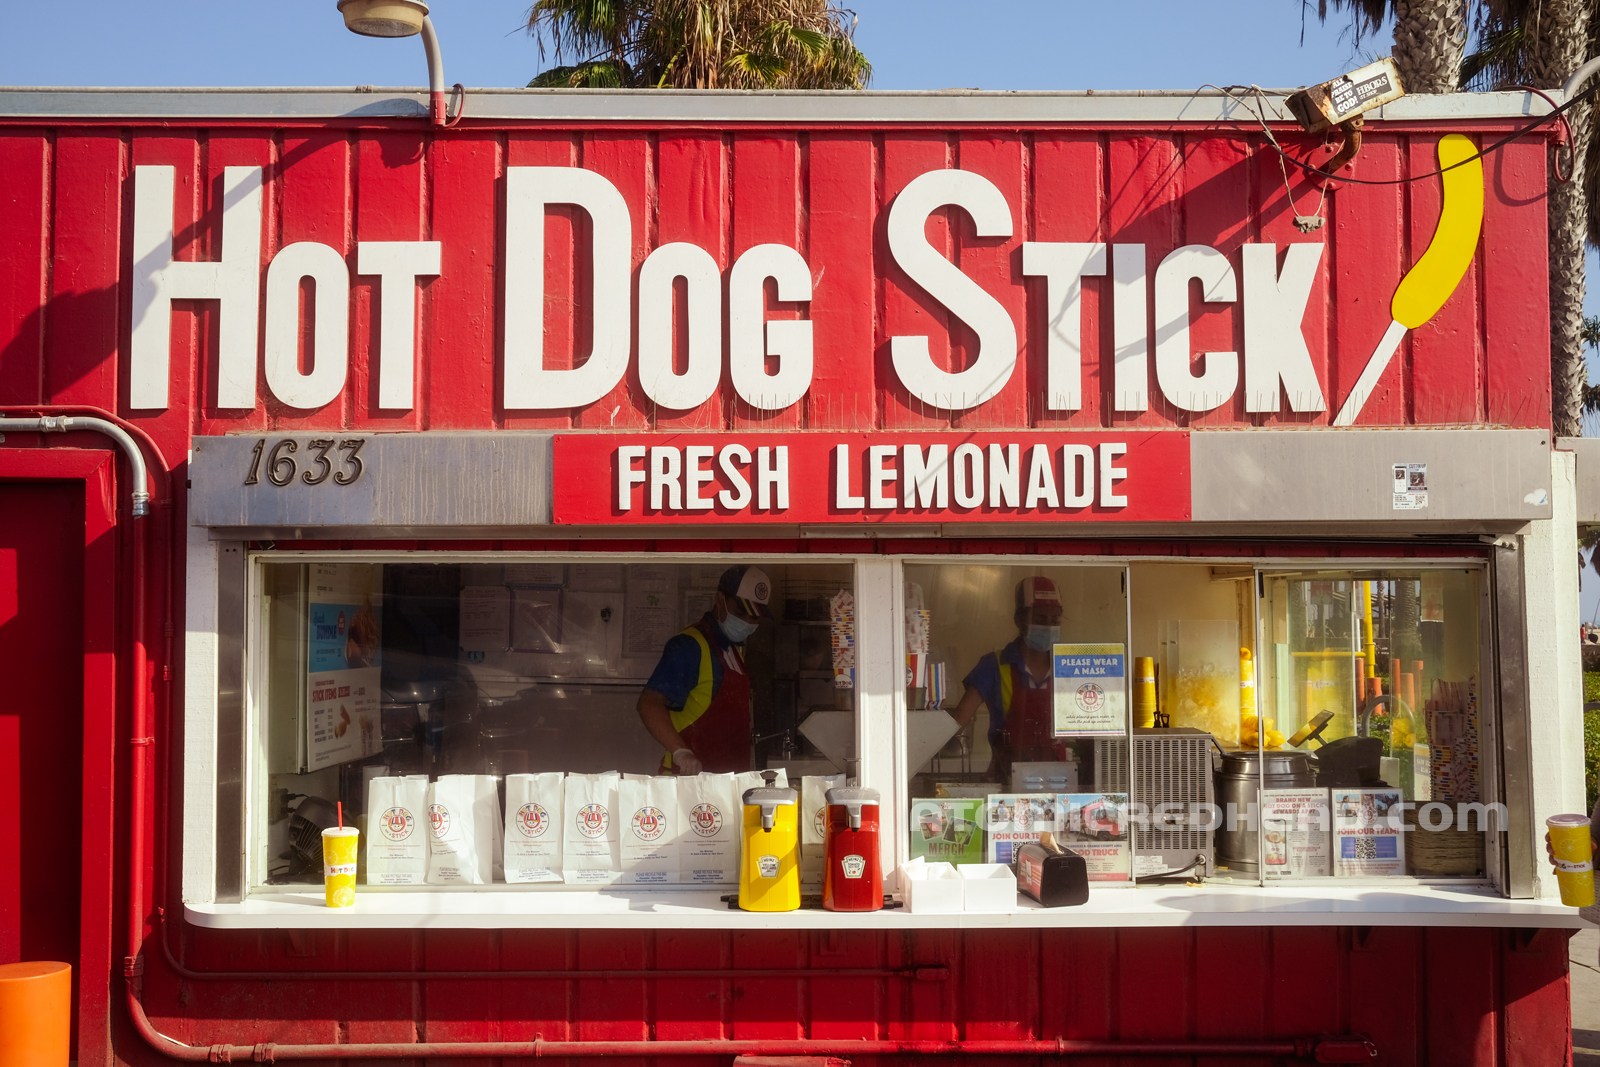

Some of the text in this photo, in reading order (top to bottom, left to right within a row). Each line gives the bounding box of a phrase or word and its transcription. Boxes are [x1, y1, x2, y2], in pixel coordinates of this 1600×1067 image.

[1332, 81, 1352, 98] PRAISE
[1335, 94, 1344, 104] BE
[1344, 90, 1353, 99] TO
[1337, 96, 1358, 112] GOD!
[129, 165, 1328, 413] HOT DOG STICK
[244, 437, 366, 487] 1633
[618, 442, 1128, 512] FRESH LEMONADE
[383, 809, 395, 820] HOT
[519, 805, 530, 816] HOT
[580, 806, 592, 817] HOT
[634, 809, 646, 821] HOT
[692, 806, 702, 817] HOT
[392, 829, 409, 838] STICK
[528, 826, 543, 834] STICK
[588, 826, 604, 834] STICK
[644, 828, 660, 838] STICK
[701, 825, 718, 834] STICK
[929, 843, 964, 855] MERCH
